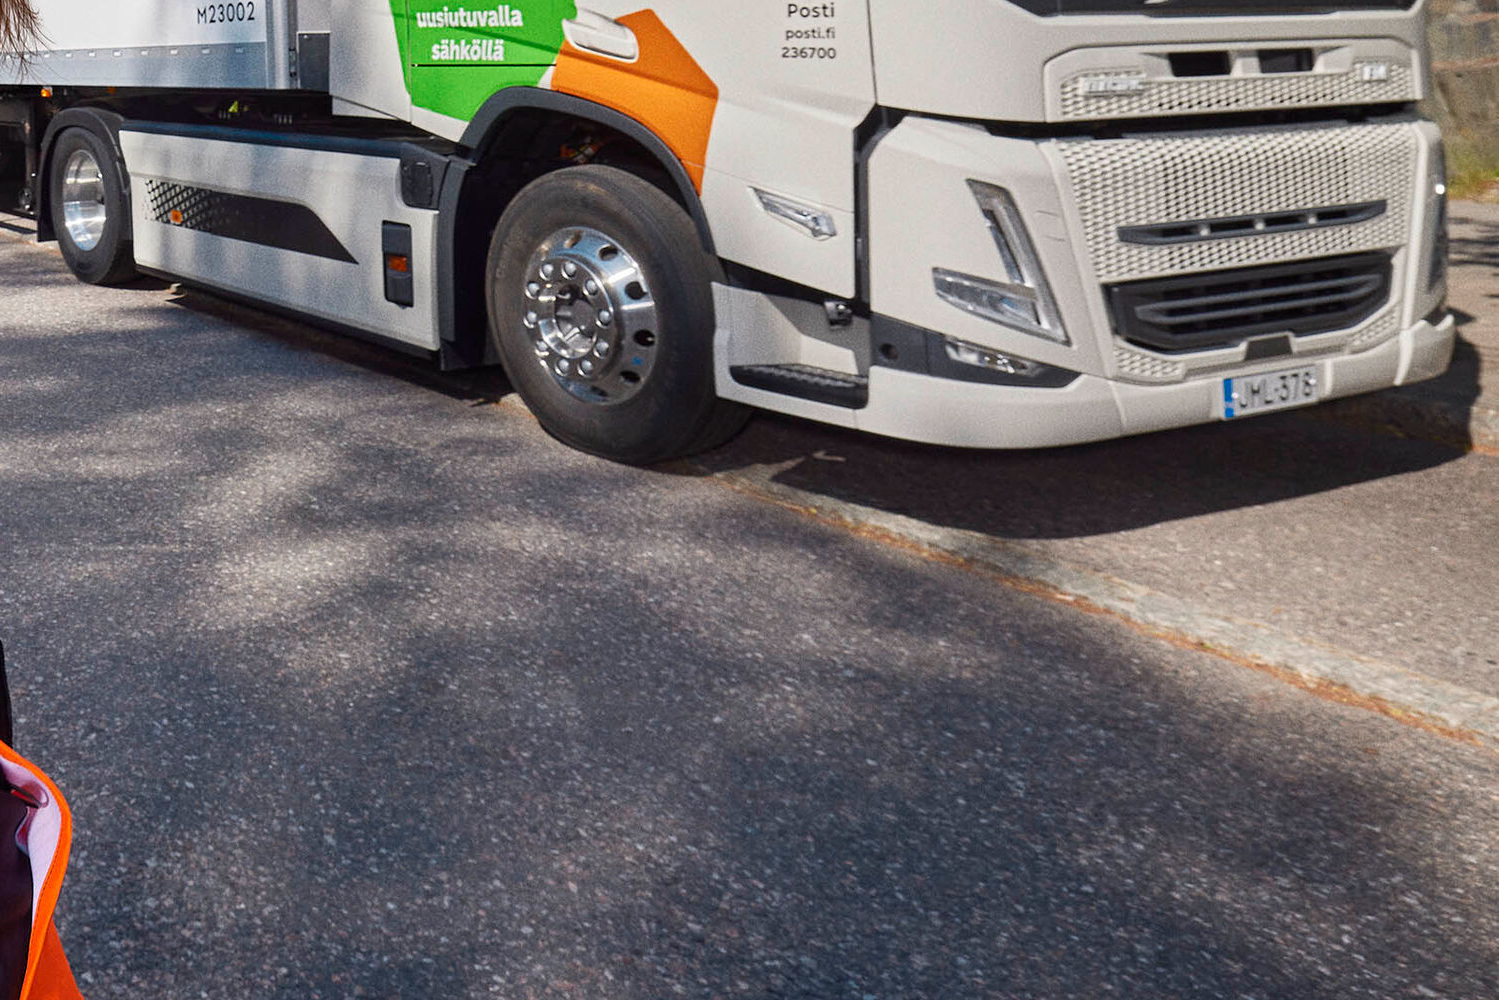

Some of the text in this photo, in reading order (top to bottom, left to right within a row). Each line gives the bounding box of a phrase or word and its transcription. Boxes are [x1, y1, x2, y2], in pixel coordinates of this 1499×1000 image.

[197, 1, 256, 24] M23002
[416, 4, 524, 28] uusiutuvalla
[787, 1, 835, 18] Posti
[785, 26, 836, 41] posti.fi
[431, 38, 505, 61] sähköllä
[781, 46, 837, 59] 236700
